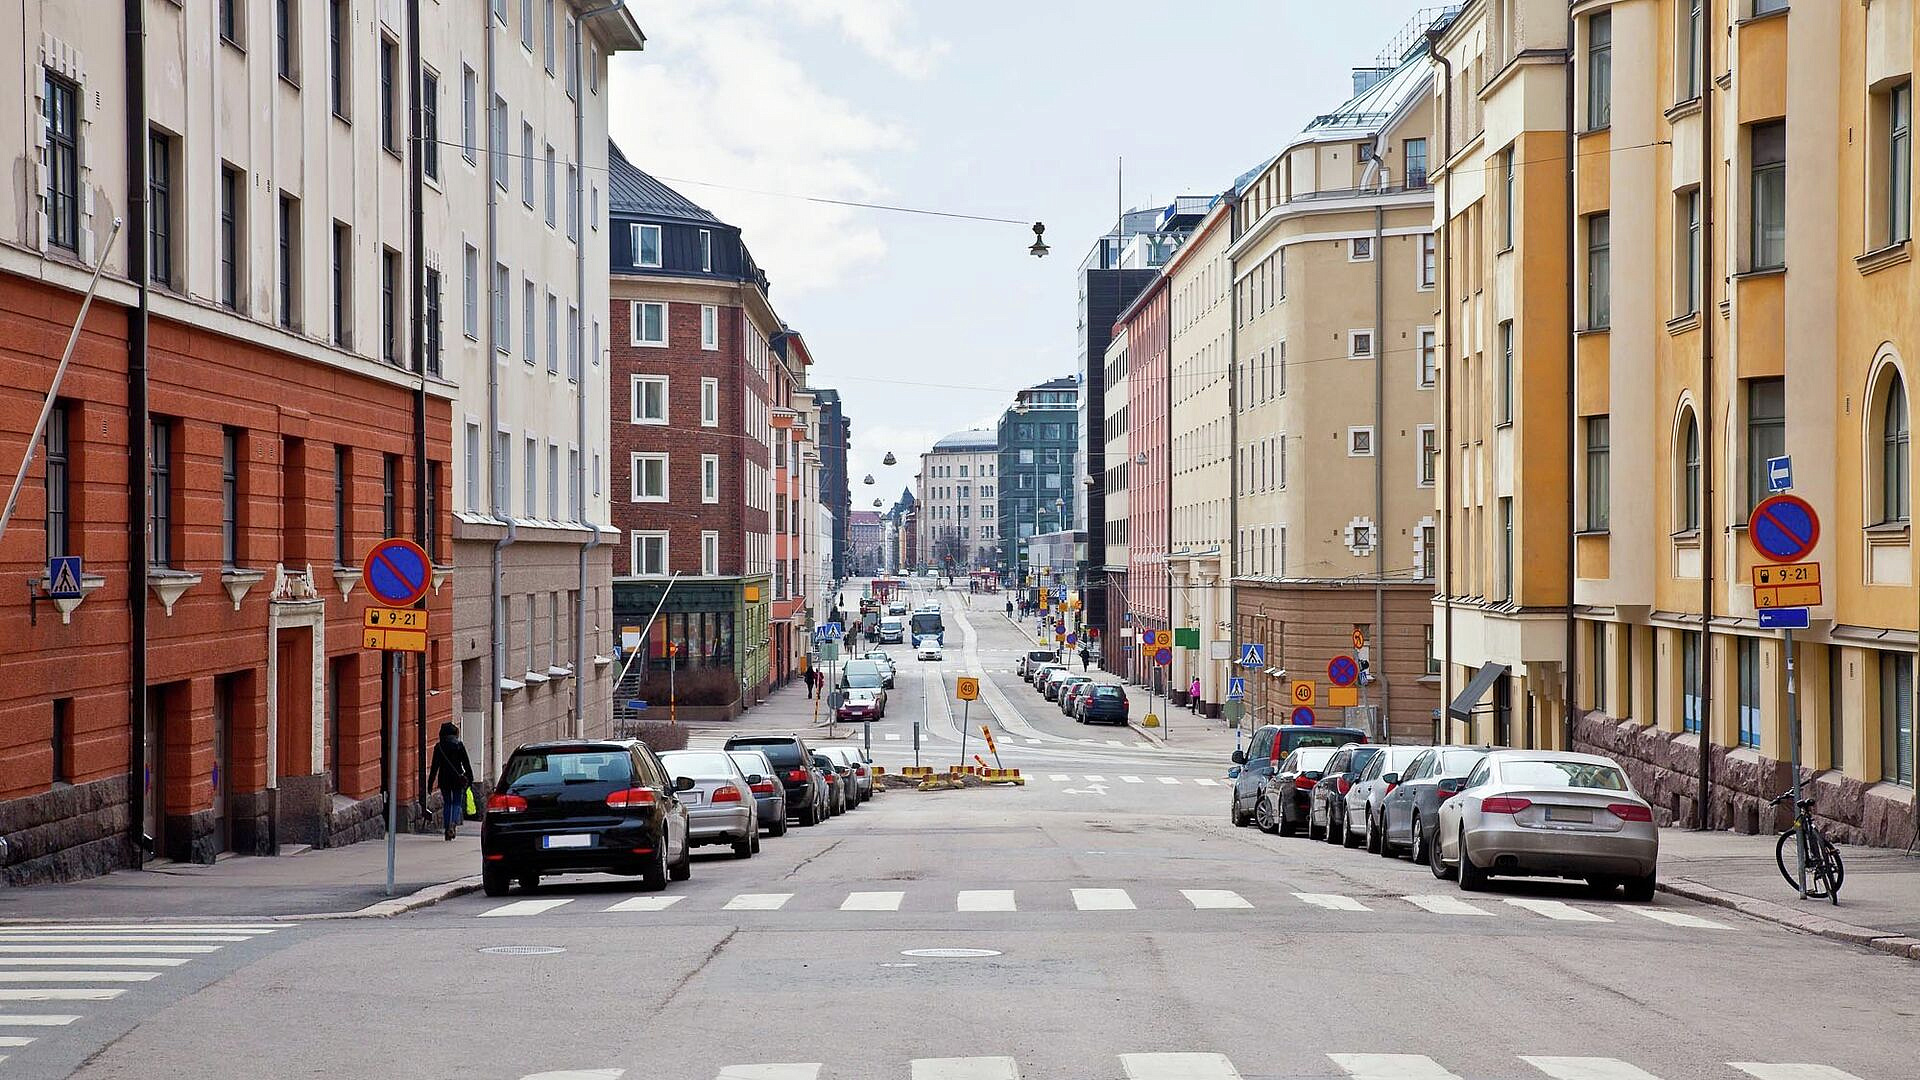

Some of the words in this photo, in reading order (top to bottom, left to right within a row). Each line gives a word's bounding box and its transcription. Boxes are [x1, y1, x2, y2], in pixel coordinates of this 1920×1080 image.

[1763, 596, 1770, 606] 2
[370, 637, 377, 647] 2
[963, 684, 972, 692] 40
[1298, 688, 1309, 697] 40
